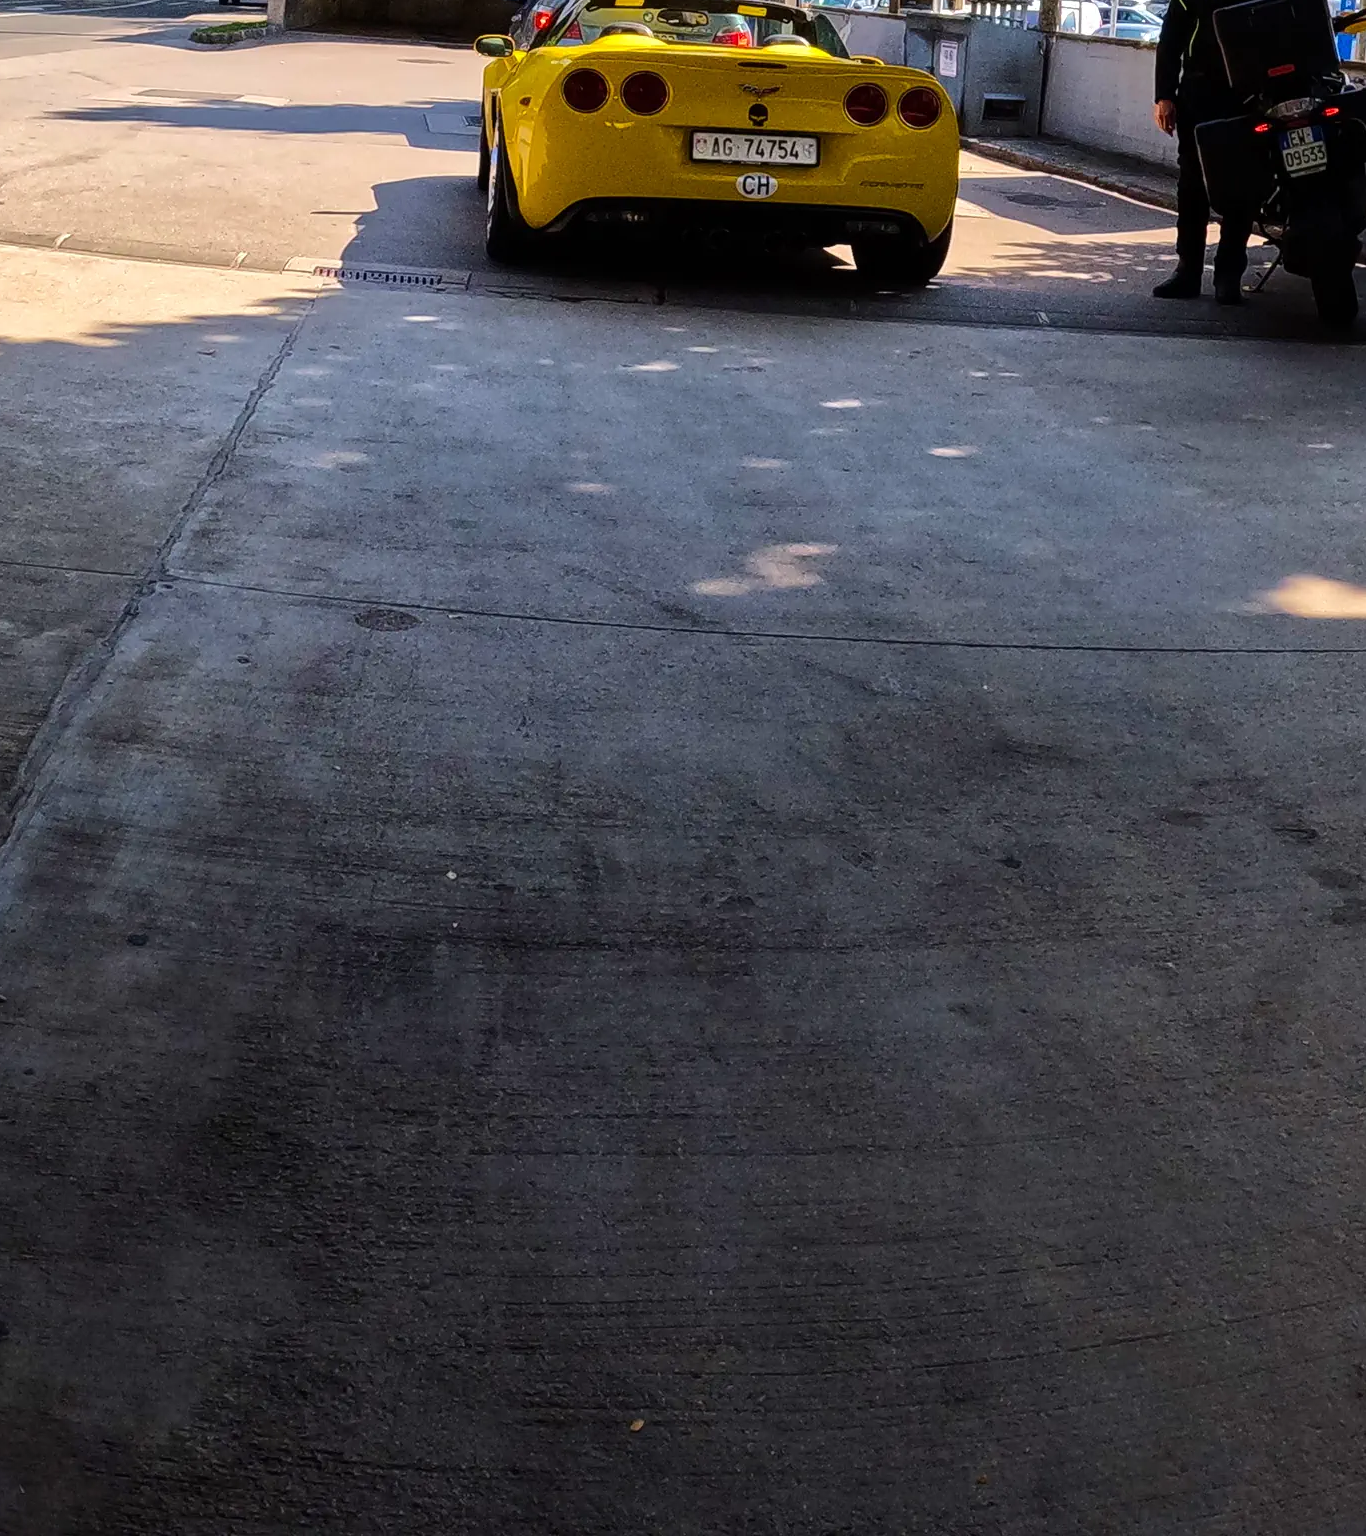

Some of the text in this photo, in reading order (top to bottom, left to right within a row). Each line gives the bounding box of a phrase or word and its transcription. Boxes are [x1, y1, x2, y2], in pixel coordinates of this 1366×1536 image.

[711, 137, 799, 160] AG 74754
[1285, 145, 1325, 167] 09533
[742, 175, 770, 195] CH
